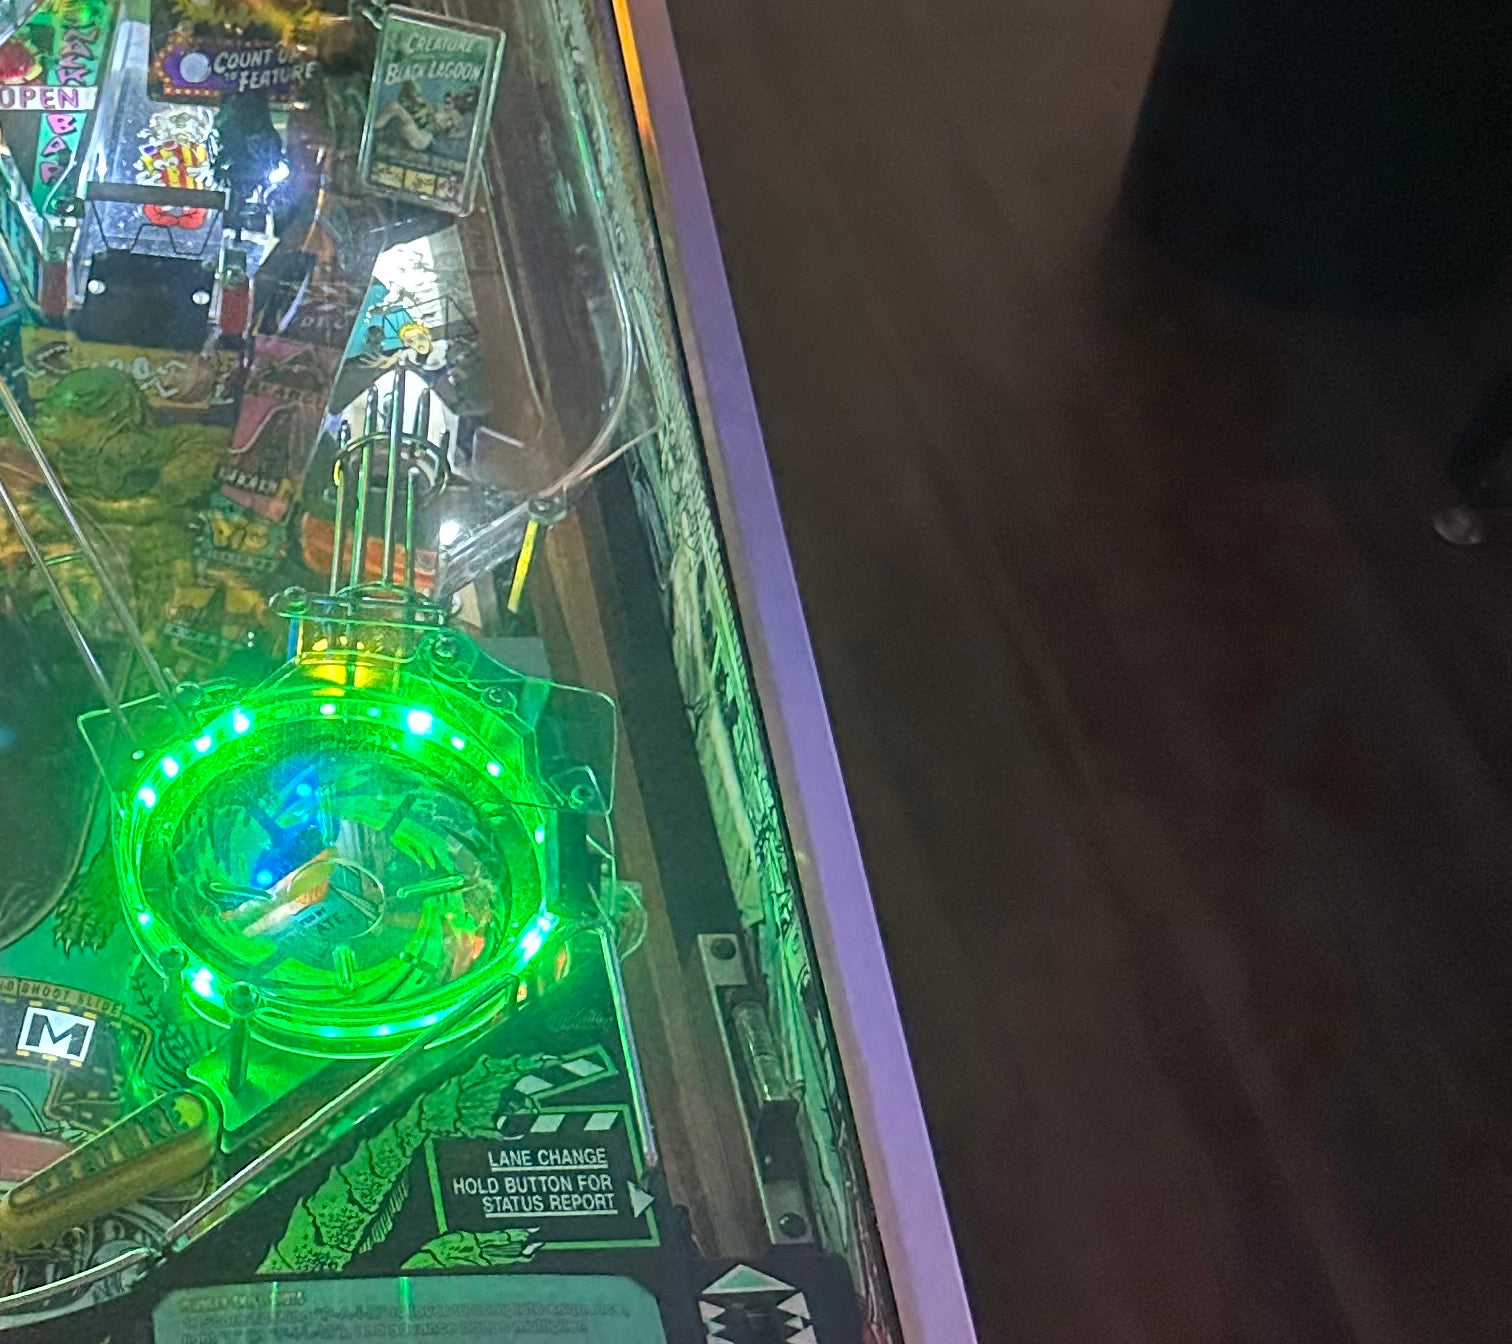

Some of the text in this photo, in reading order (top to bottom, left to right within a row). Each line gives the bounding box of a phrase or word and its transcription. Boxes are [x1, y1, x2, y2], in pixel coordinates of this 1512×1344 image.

[212, 50, 276, 75] COUNT
[238, 60, 315, 92] FEATURE
[488, 1147, 608, 1167] LANE CHANGE
[452, 1173, 614, 1195] HOLD BUTTON FOR
[482, 1192, 615, 1214] STATUS REPORT
